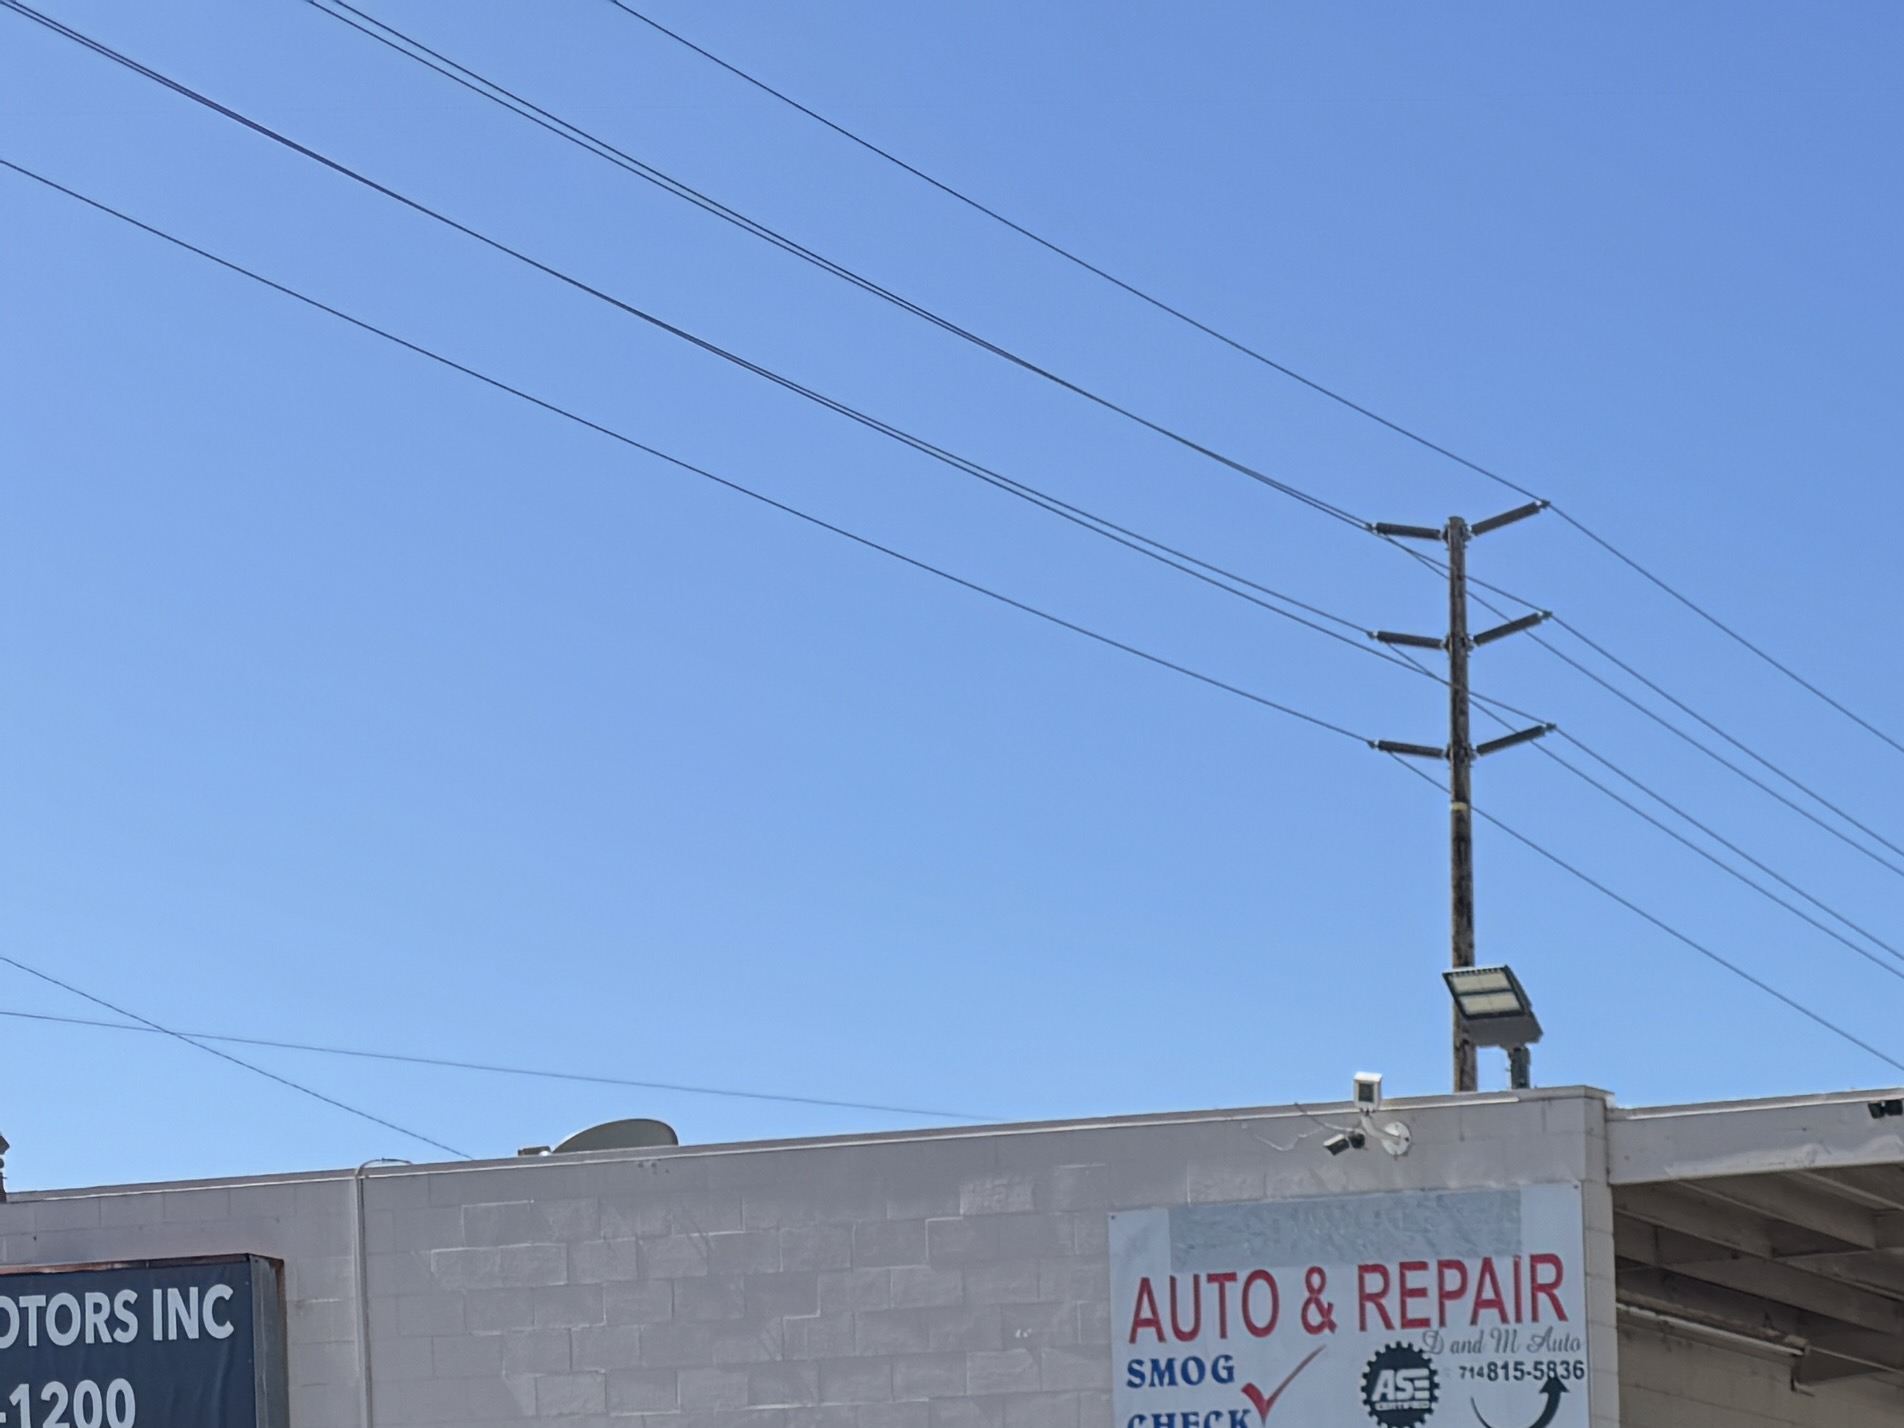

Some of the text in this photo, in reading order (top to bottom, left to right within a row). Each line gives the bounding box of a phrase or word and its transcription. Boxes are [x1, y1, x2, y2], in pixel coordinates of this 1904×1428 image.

[152, 1284, 235, 1341] INC
[1128, 1253, 1569, 1345] AUTO & REPAIR
[1421, 1326, 1582, 1355] D and M Auto
[1125, 1354, 1235, 1389] SMOG
[1371, 1368, 1431, 1401] ASE
